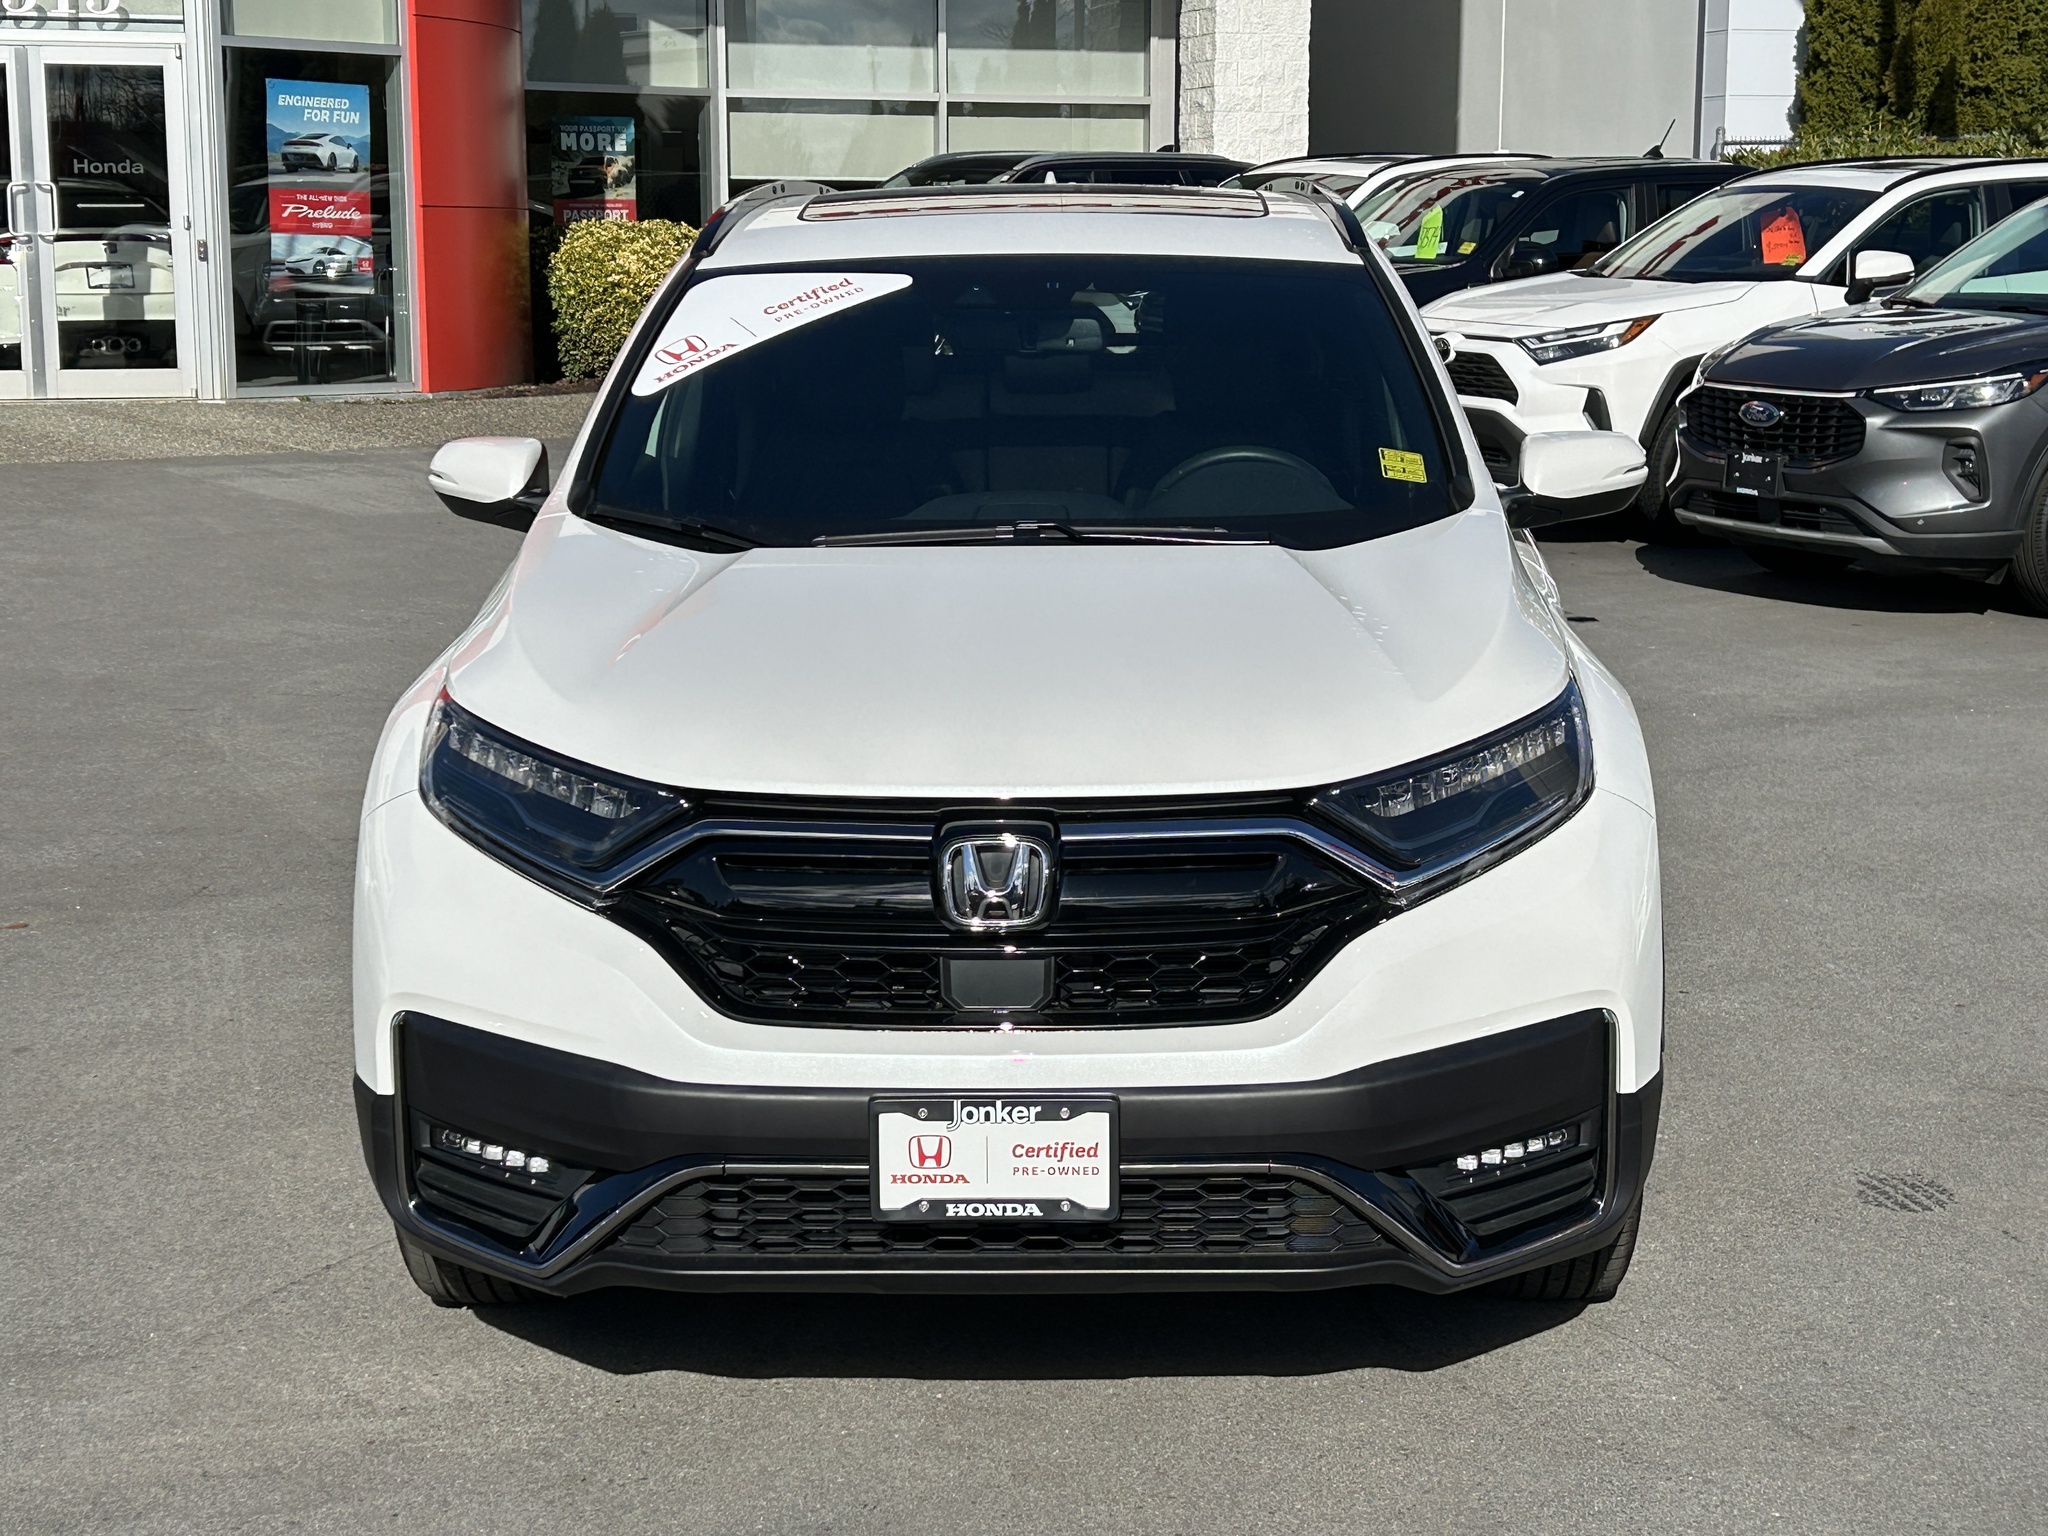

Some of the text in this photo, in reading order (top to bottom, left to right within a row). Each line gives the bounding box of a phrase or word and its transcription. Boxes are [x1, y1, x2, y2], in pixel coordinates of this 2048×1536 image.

[278, 94, 350, 110] ENGINEERED
[303, 108, 360, 125] FOR FUN
[580, 125, 615, 133] PASSPORT
[560, 132, 627, 152] MORE
[73, 158, 144, 174] Honda
[281, 203, 362, 220] Prelude
[563, 209, 630, 222] PASSPORT
[763, 278, 854, 315] Certified
[774, 286, 865, 323] PRE-OWNED
[654, 343, 740, 384] HONDA
[946, 1100, 1042, 1132] Jonker
[1012, 1141, 1099, 1162] Certified
[890, 1174, 970, 1185] HONDA
[1012, 1166, 1100, 1176] PRE-OWNED
[945, 1203, 1044, 1217] HONDA
